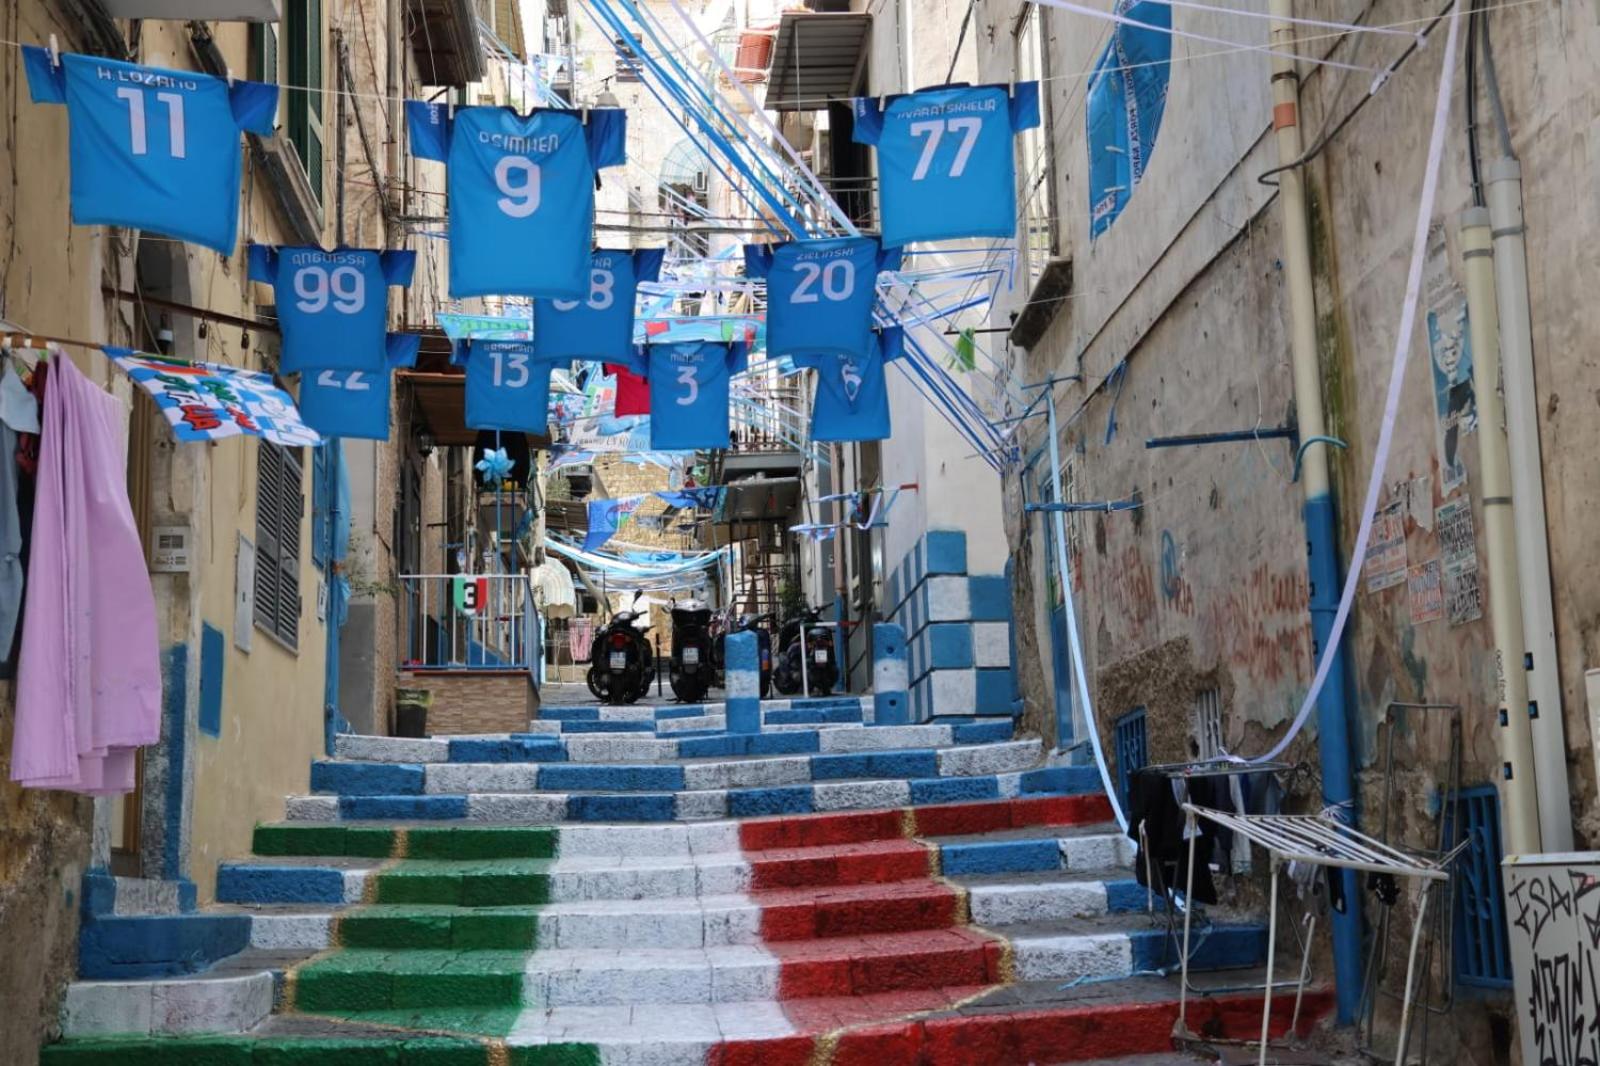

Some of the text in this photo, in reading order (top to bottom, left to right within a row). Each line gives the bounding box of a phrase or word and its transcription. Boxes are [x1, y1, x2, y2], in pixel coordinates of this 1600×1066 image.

[117, 87, 186, 159] 11
[910, 116, 983, 181] 77
[494, 155, 541, 218] 9
[293, 266, 365, 314] 99
[552, 268, 615, 311] 8
[789, 259, 856, 304] 20
[488, 352, 529, 388] 13
[676, 366, 698, 406] 3
[462, 581, 478, 609] 3
